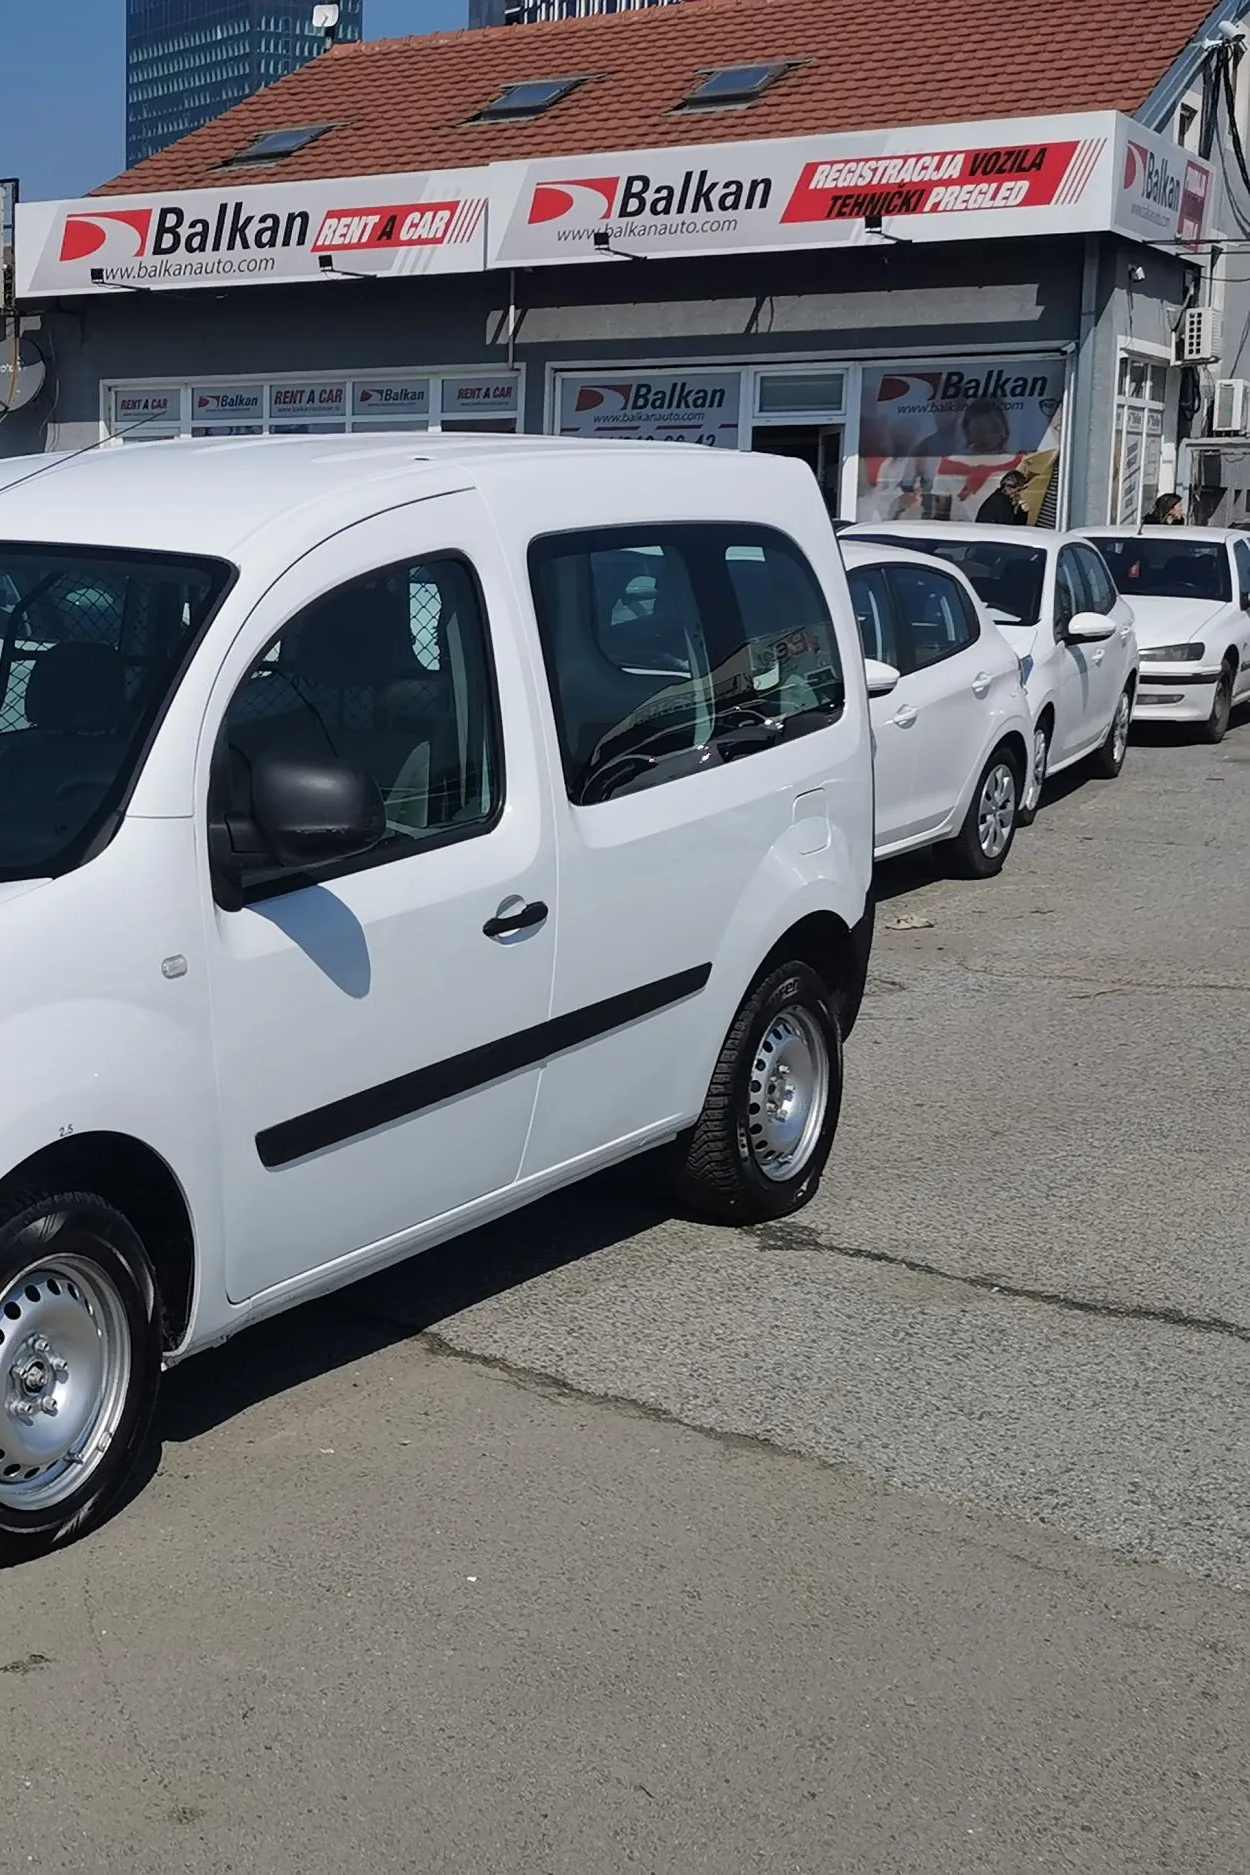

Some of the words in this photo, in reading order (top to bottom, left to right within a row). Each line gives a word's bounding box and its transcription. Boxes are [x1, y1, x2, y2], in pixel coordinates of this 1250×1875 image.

[808, 152, 966, 190] REGISTRACIJA
[968, 147, 1048, 177] VOZILA
[1145, 150, 1181, 213] Balkan
[618, 169, 773, 219] Balkan
[825, 182, 926, 218] TEHNIČKI
[922, 180, 1031, 213] PREGLED
[152, 201, 310, 256] Balkan
[315, 214, 381, 247] RENT
[377, 213, 398, 242] A
[399, 209, 452, 242] CAR
[557, 219, 738, 242] wwwbalkanauto.com
[104, 257, 276, 281] ww.balkanauto.com
[274, 390, 305, 405] RENT
[306, 389, 315, 404] A
[318, 388, 344, 404] CAR
[384, 388, 425, 401] Balkan
[457, 387, 482, 400] RENT
[482, 387, 491, 399] A
[492, 386, 513, 398] CAR
[631, 382, 726, 411] Balkan
[940, 369, 1048, 400] Balkan
[120, 399, 142, 410] RENT
[142, 399, 149, 410] A
[150, 398, 168, 410] CAR
[221, 394, 258, 408] Balkan
[593, 411, 705, 424] www.balkanauto.com
